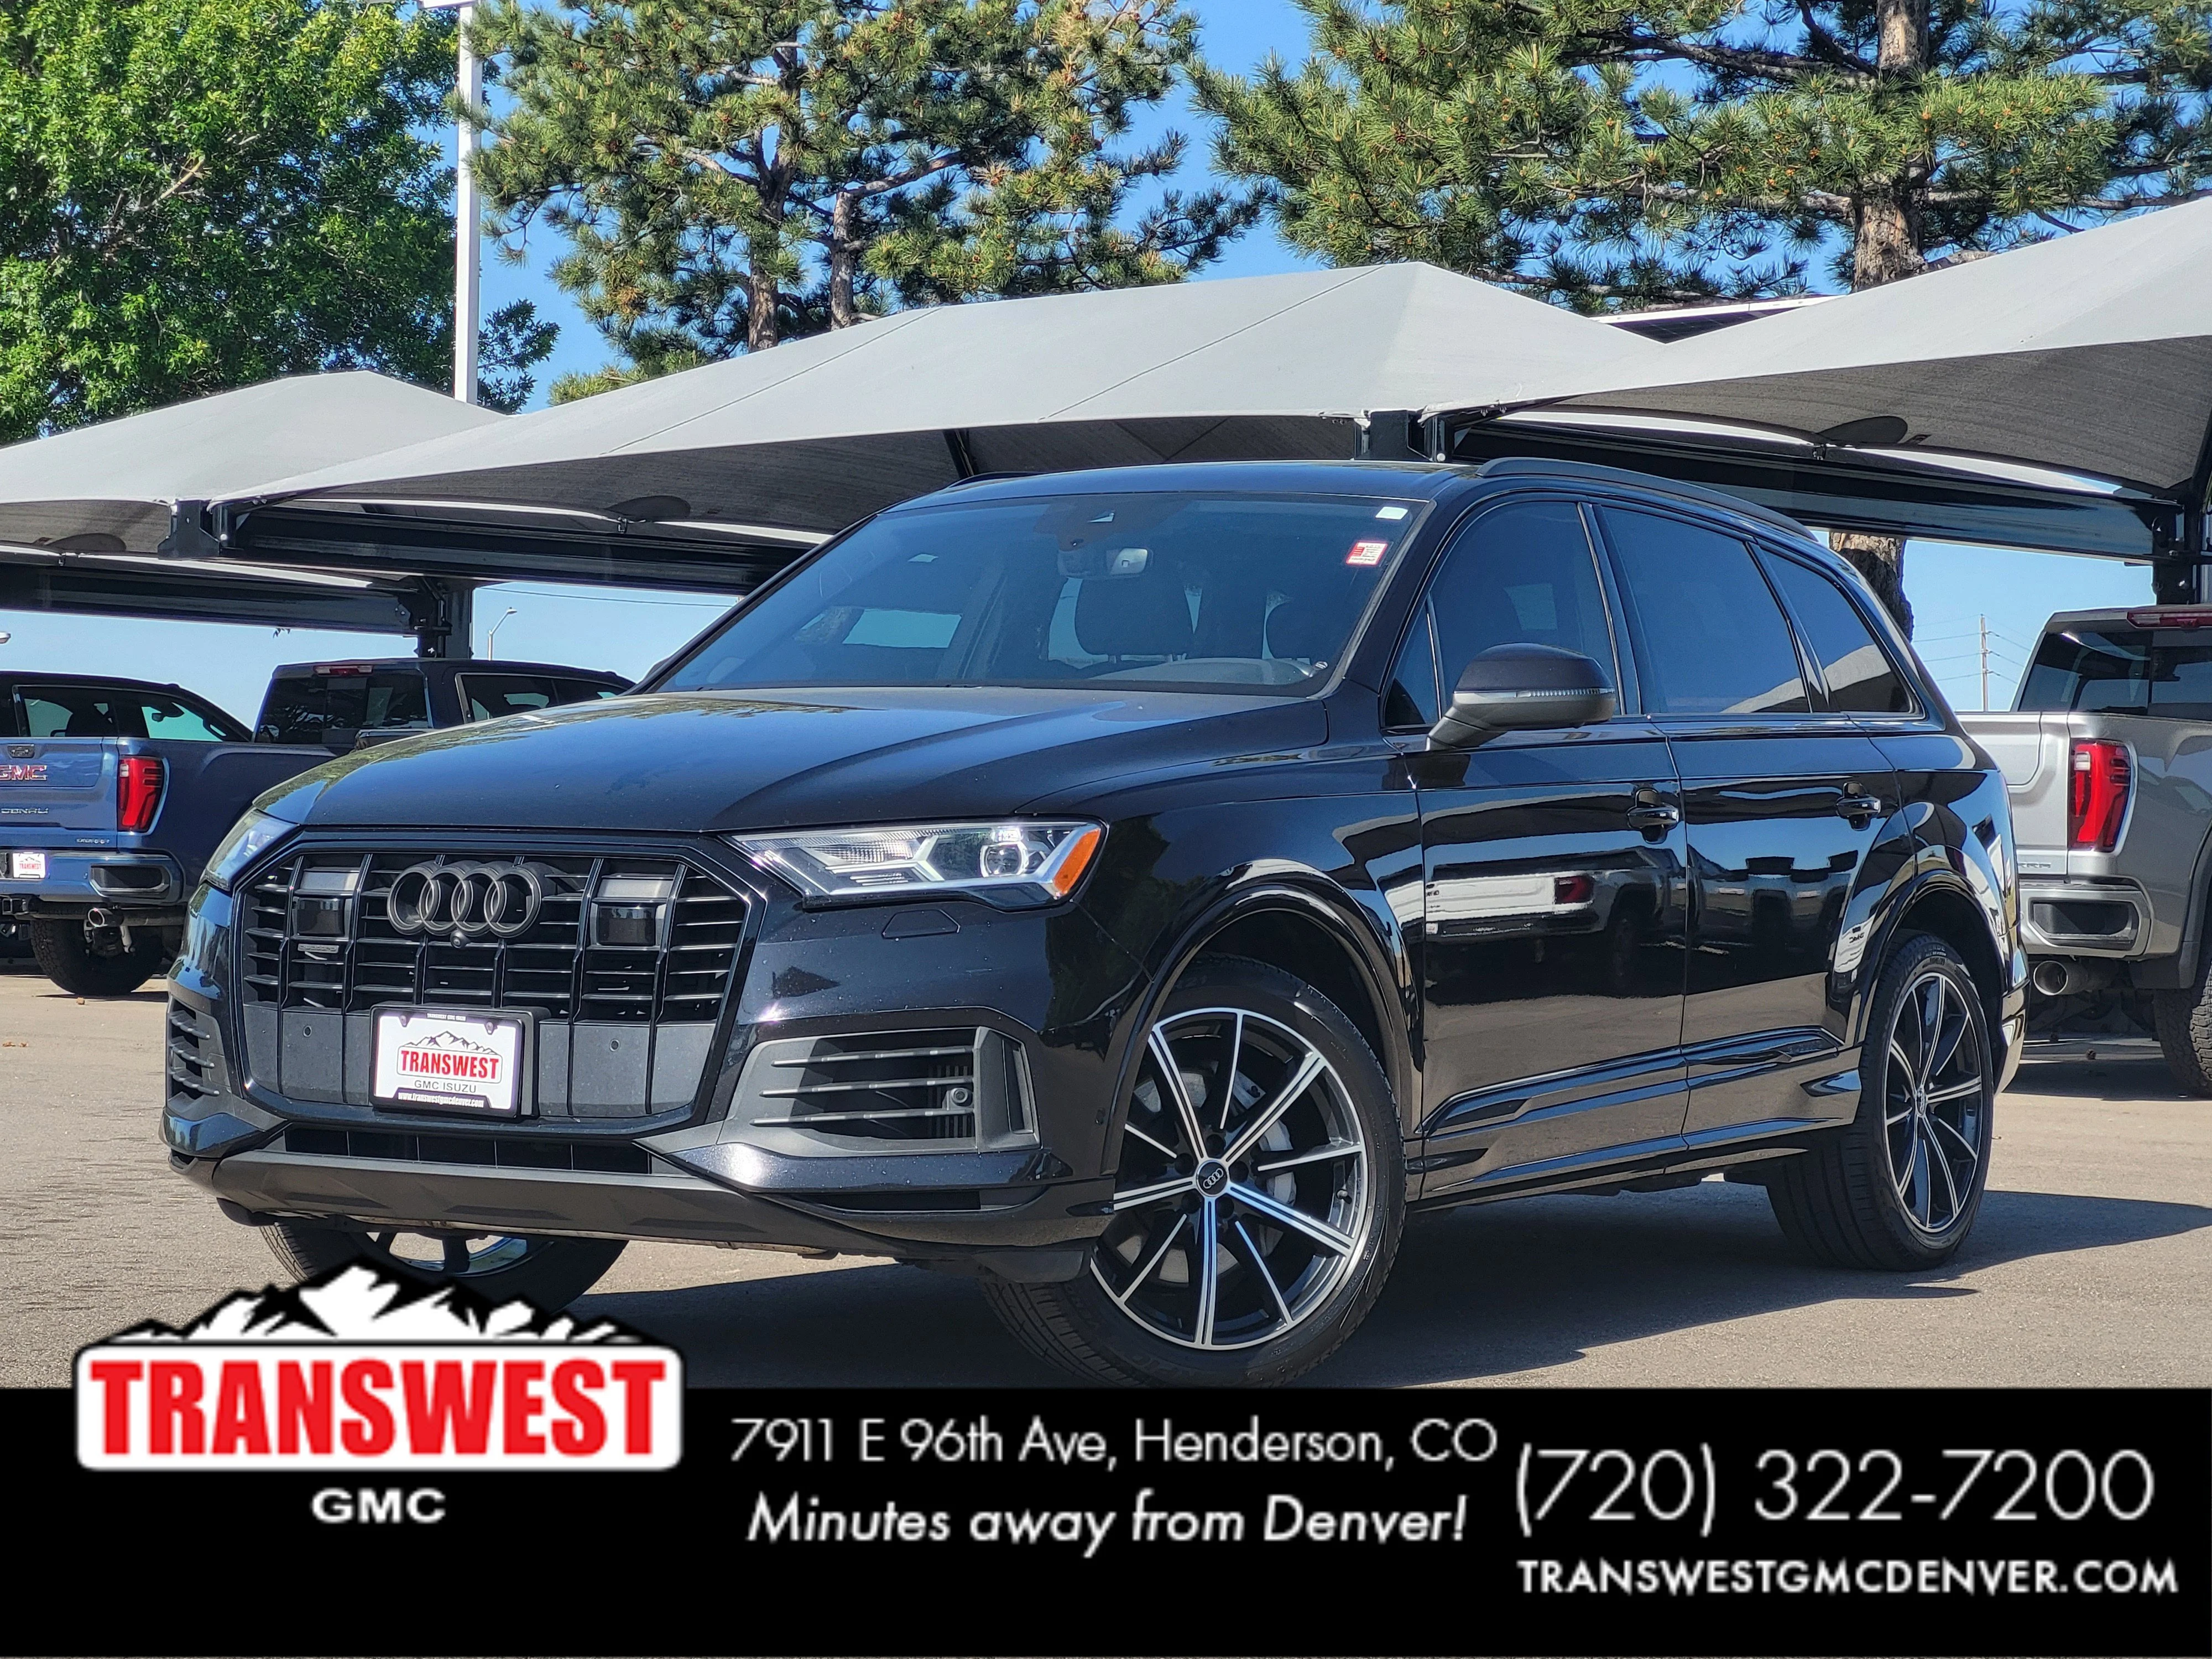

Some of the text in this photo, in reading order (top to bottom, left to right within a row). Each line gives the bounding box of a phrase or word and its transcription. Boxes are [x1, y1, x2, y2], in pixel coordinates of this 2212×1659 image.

[0, 765, 47, 781] GMC
[401, 1050, 499, 1079] TRANSWEST
[414, 1079, 476, 1093] GMC ISUZU
